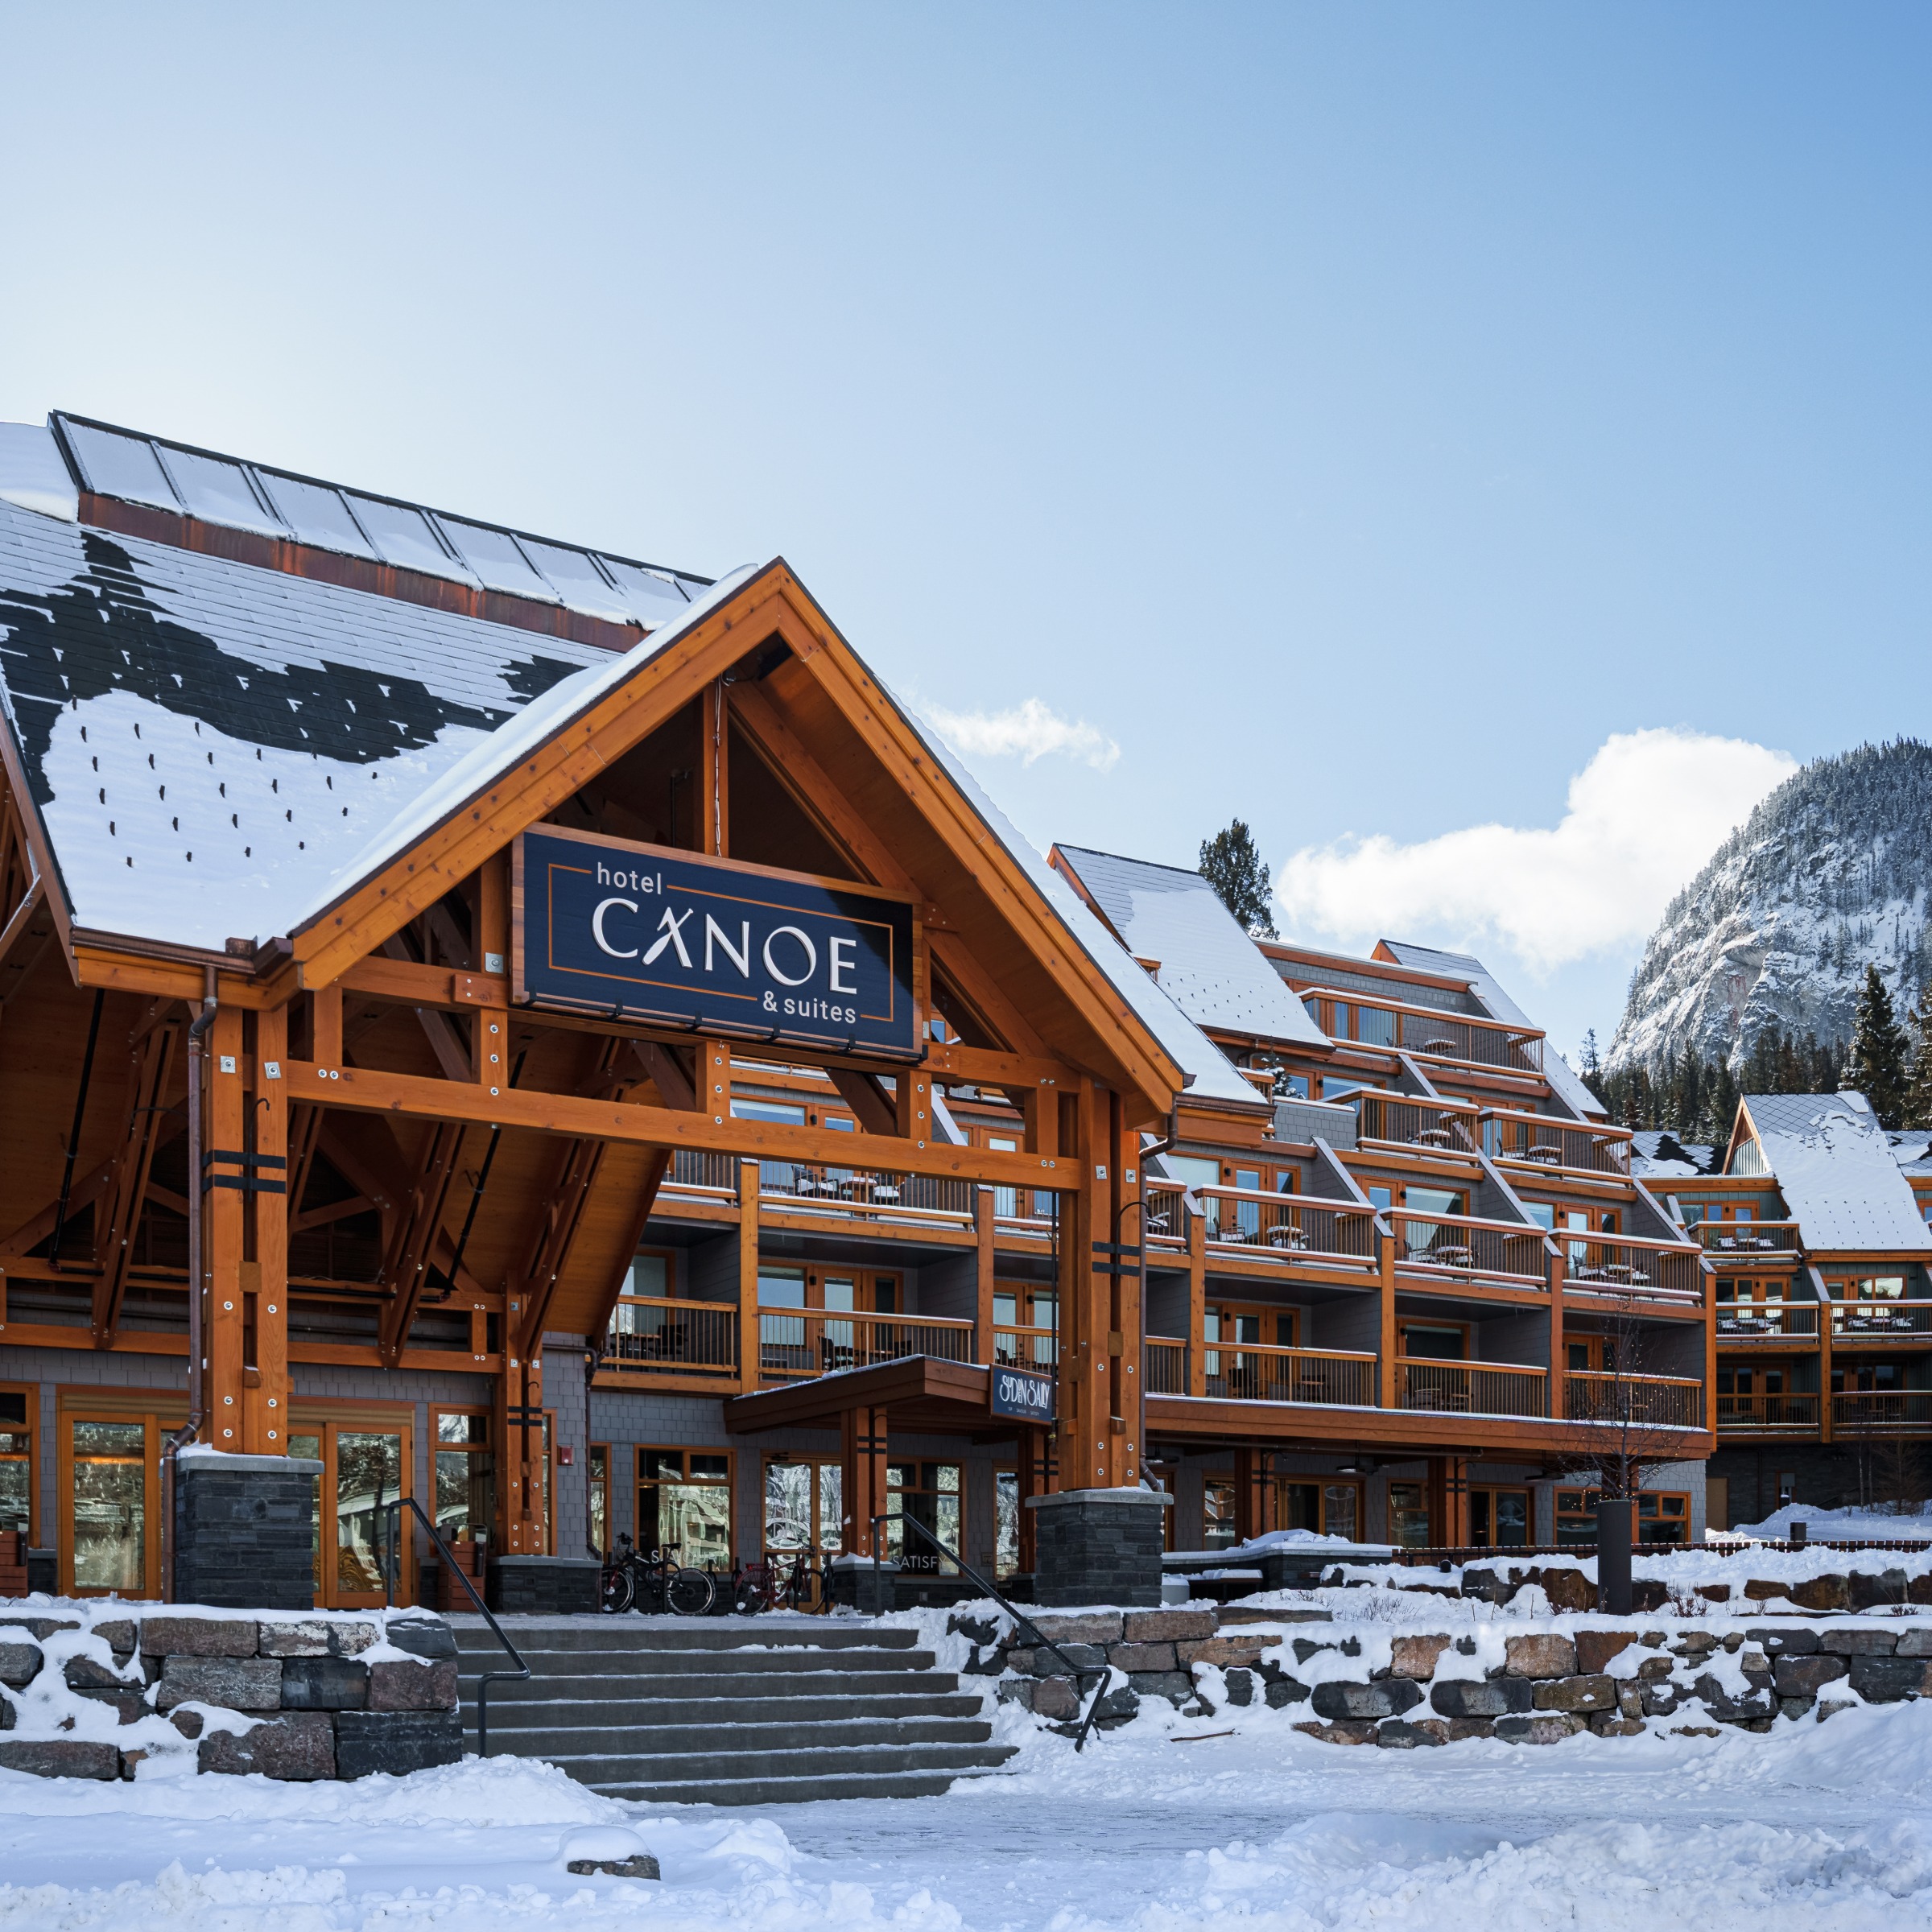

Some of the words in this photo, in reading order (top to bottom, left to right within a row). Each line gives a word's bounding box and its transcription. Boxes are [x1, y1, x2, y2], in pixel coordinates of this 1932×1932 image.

[597, 862, 662, 895] hotel
[592, 898, 857, 995] CANOE
[762, 990, 778, 1013] &
[784, 997, 857, 1024] suites
